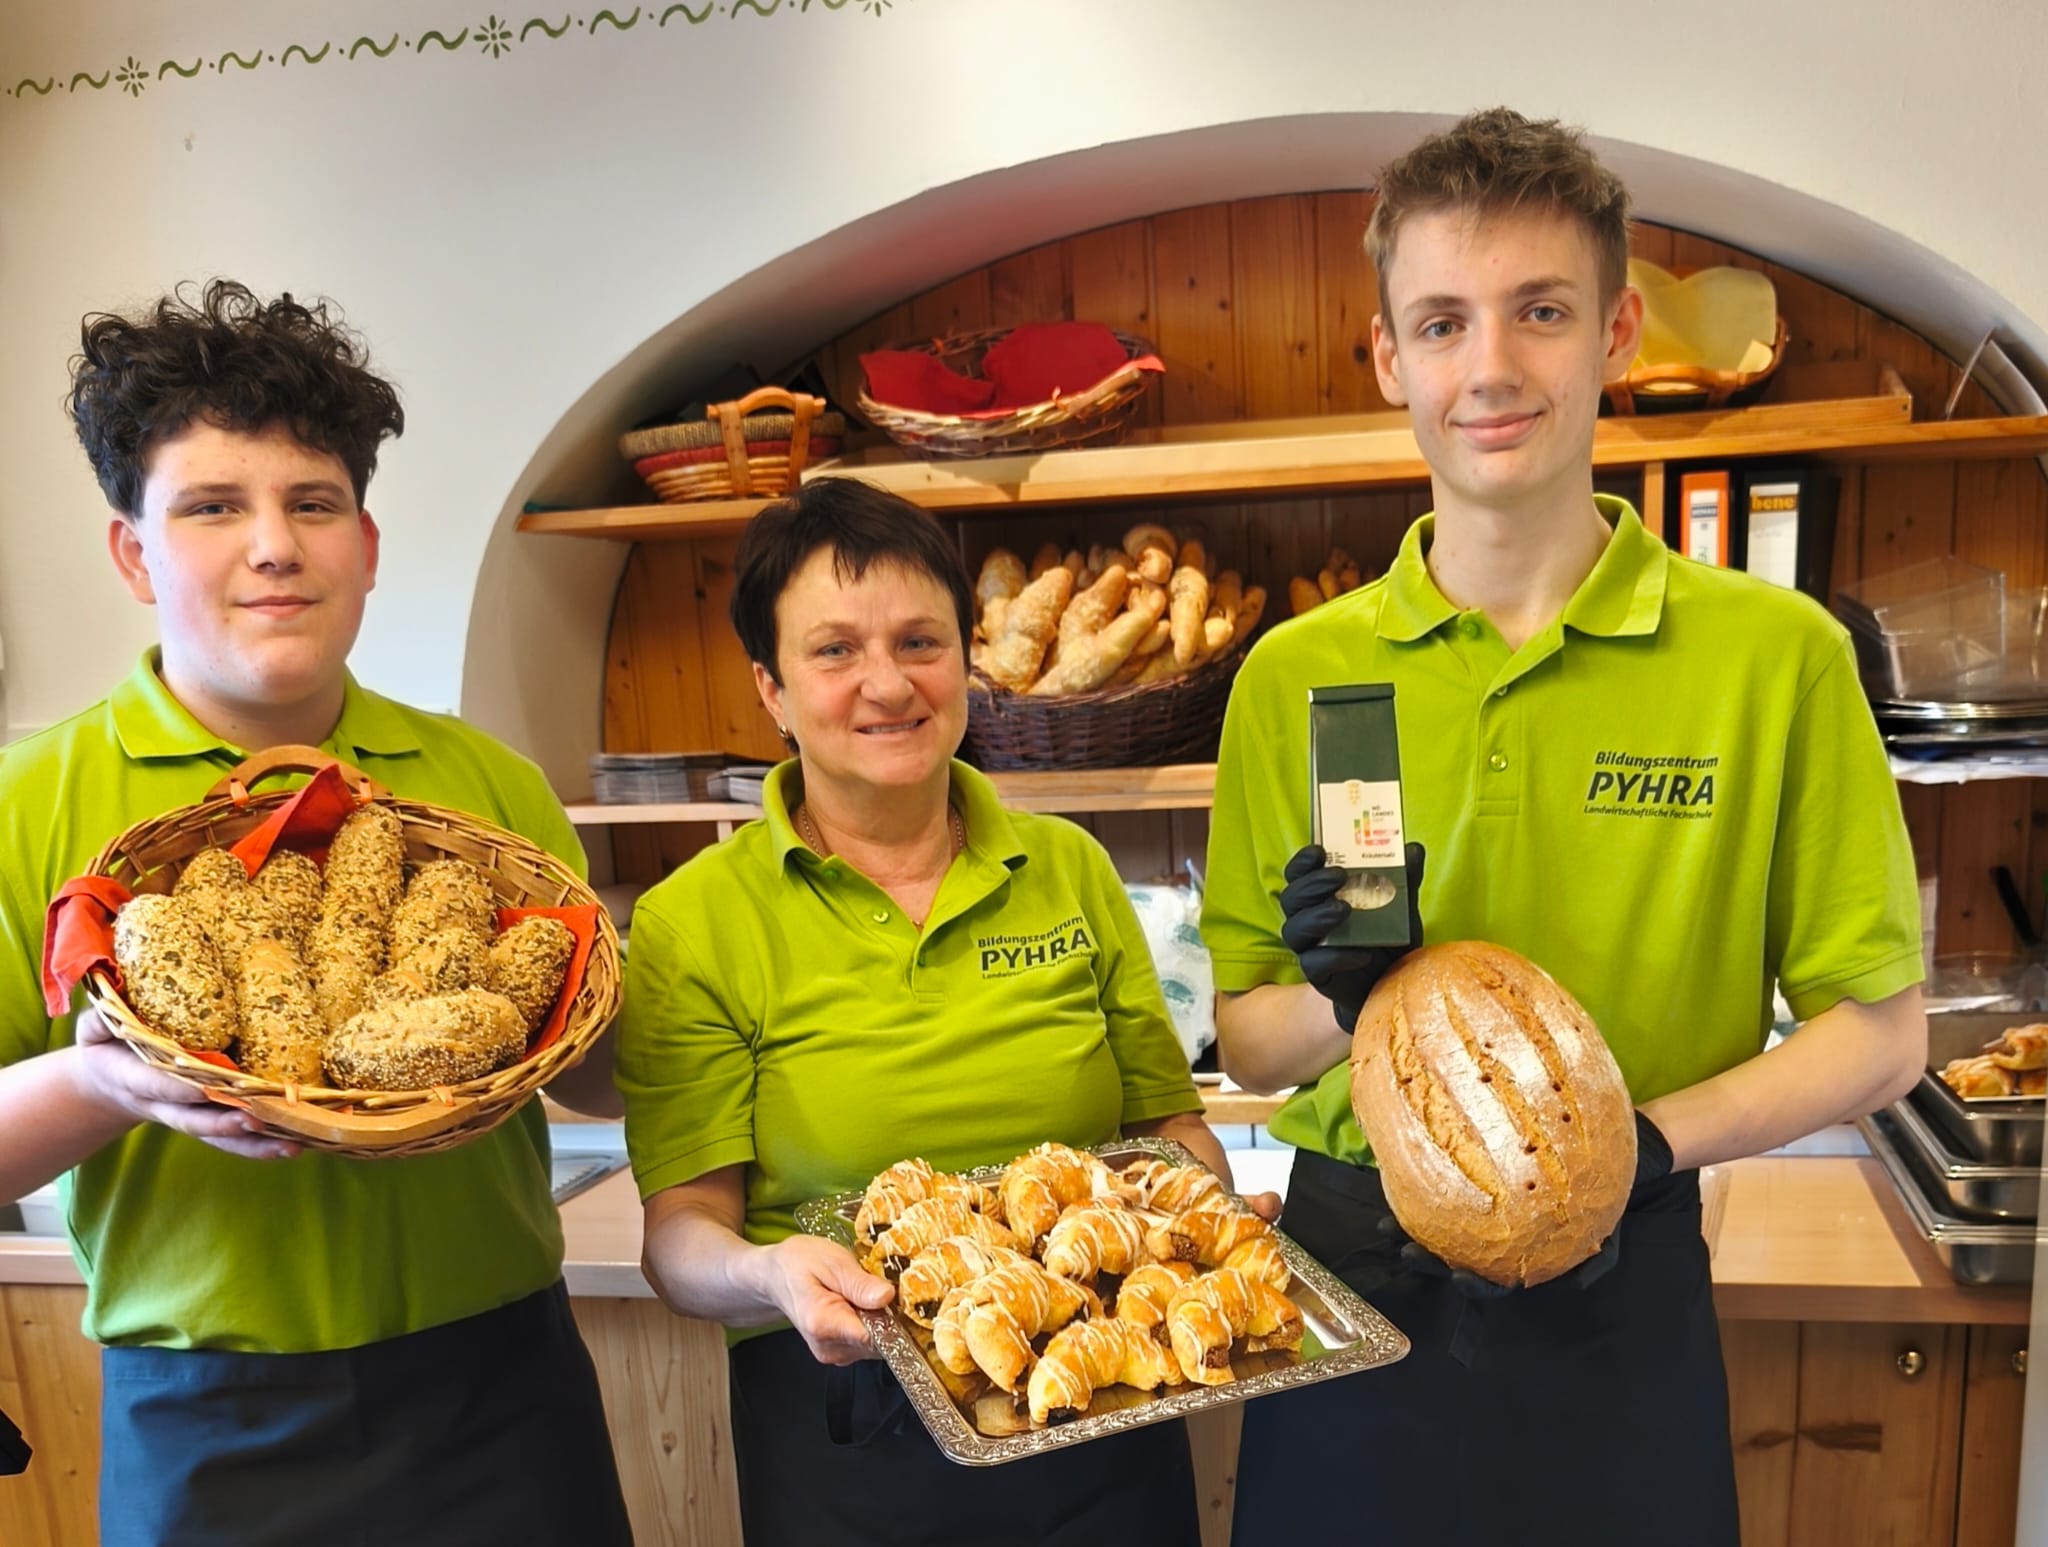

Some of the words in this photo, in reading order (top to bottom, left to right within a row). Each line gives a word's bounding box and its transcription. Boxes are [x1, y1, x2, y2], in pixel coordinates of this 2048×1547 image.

[1751, 495, 1796, 510] bene
[1595, 750, 1719, 772] Bildungszentrum
[1587, 771, 1713, 806] PYHRA
[1583, 804, 1669, 818] Landwirtschaftliche
[978, 916, 1083, 948] Bildungszentrum
[981, 928, 1092, 972] PYHRA
